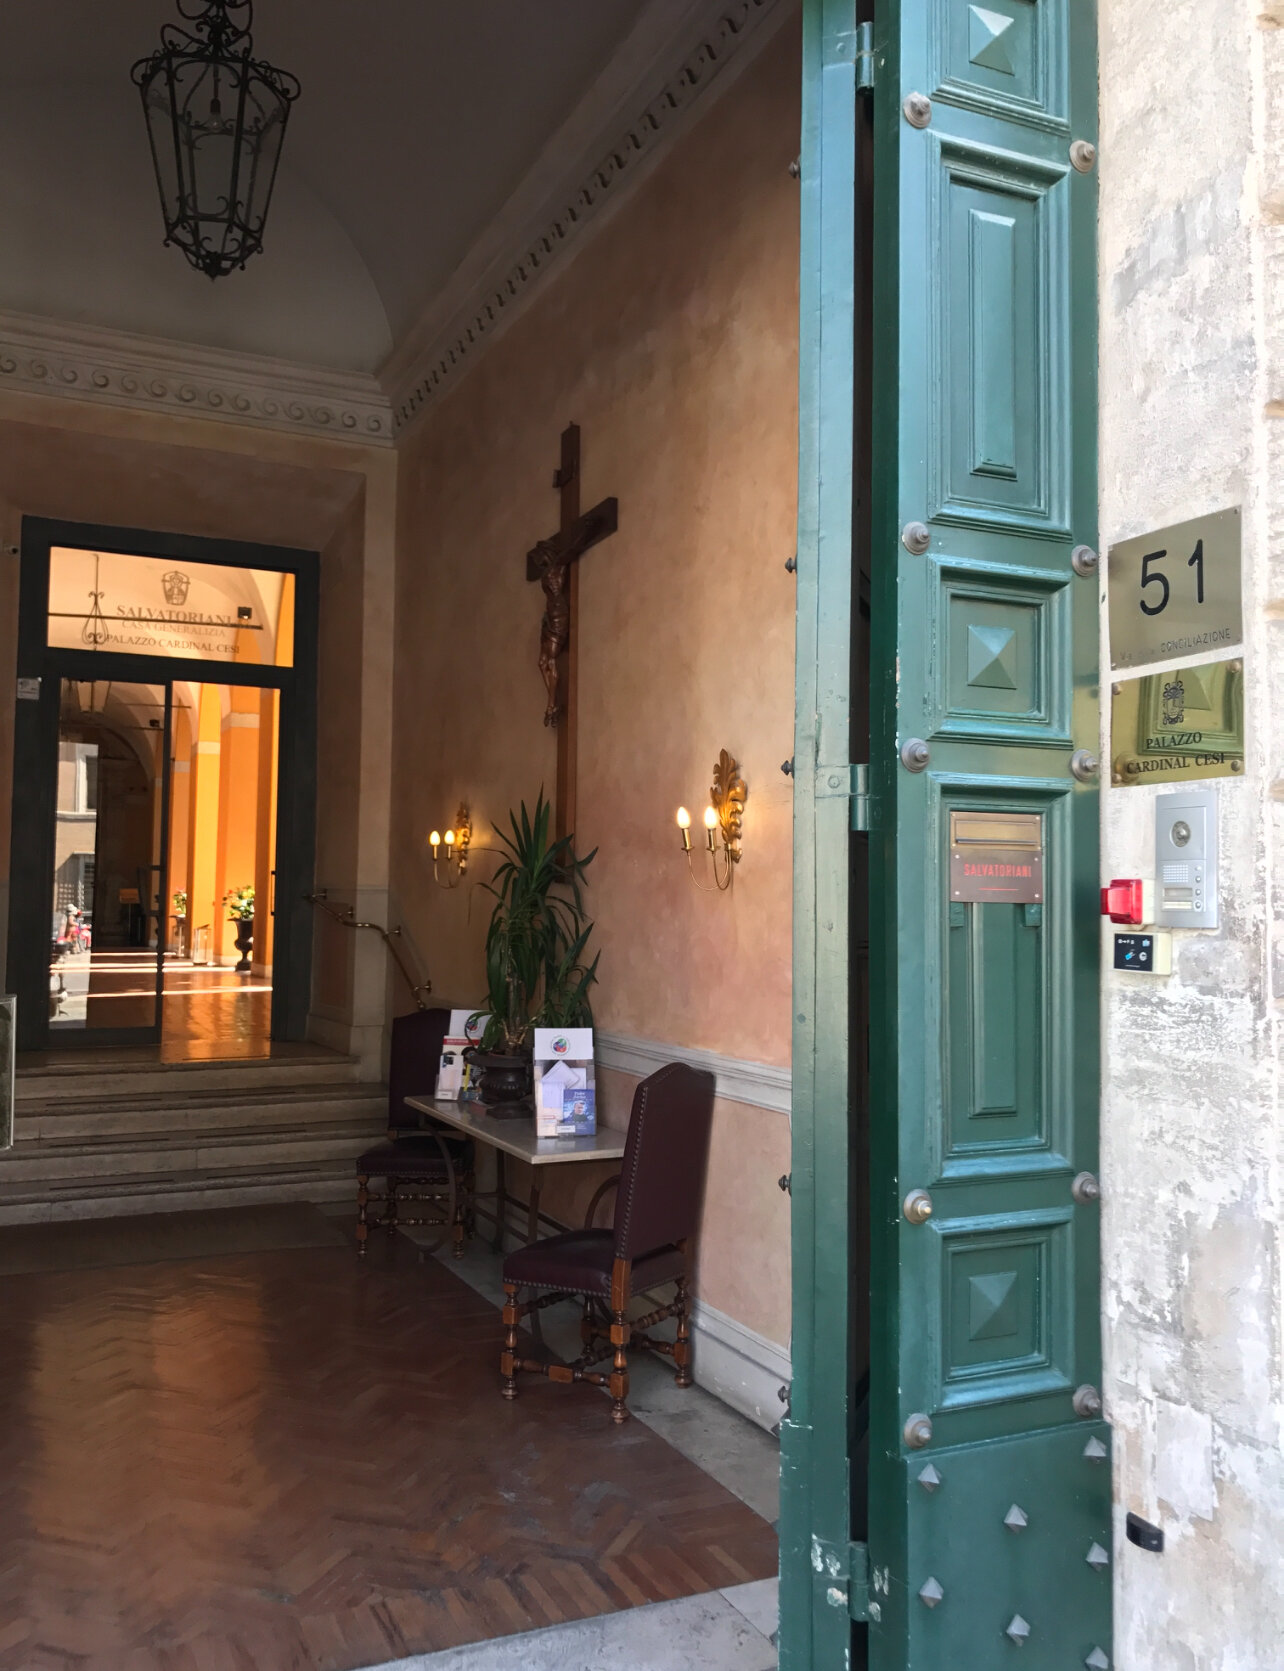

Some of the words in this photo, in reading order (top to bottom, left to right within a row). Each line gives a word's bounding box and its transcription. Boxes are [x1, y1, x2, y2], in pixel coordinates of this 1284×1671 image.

[1140, 539, 1204, 616] 51
[117, 605, 231, 627] SALVATORIANI
[121, 619, 152, 632] CASA
[154, 622, 225, 638] GENERALIZIA
[107, 634, 157, 648] PALAZZO
[158, 638, 214, 652] CARDINAL
[216, 643, 240, 654] CESI
[1160, 627, 1232, 653] CONCILIAZIONE
[1146, 731, 1203, 750] PALAZZO
[1127, 756, 1190, 774] CARDINAL
[1195, 752, 1226, 767] CESI
[963, 863, 1033, 878] SALVATORIANI
